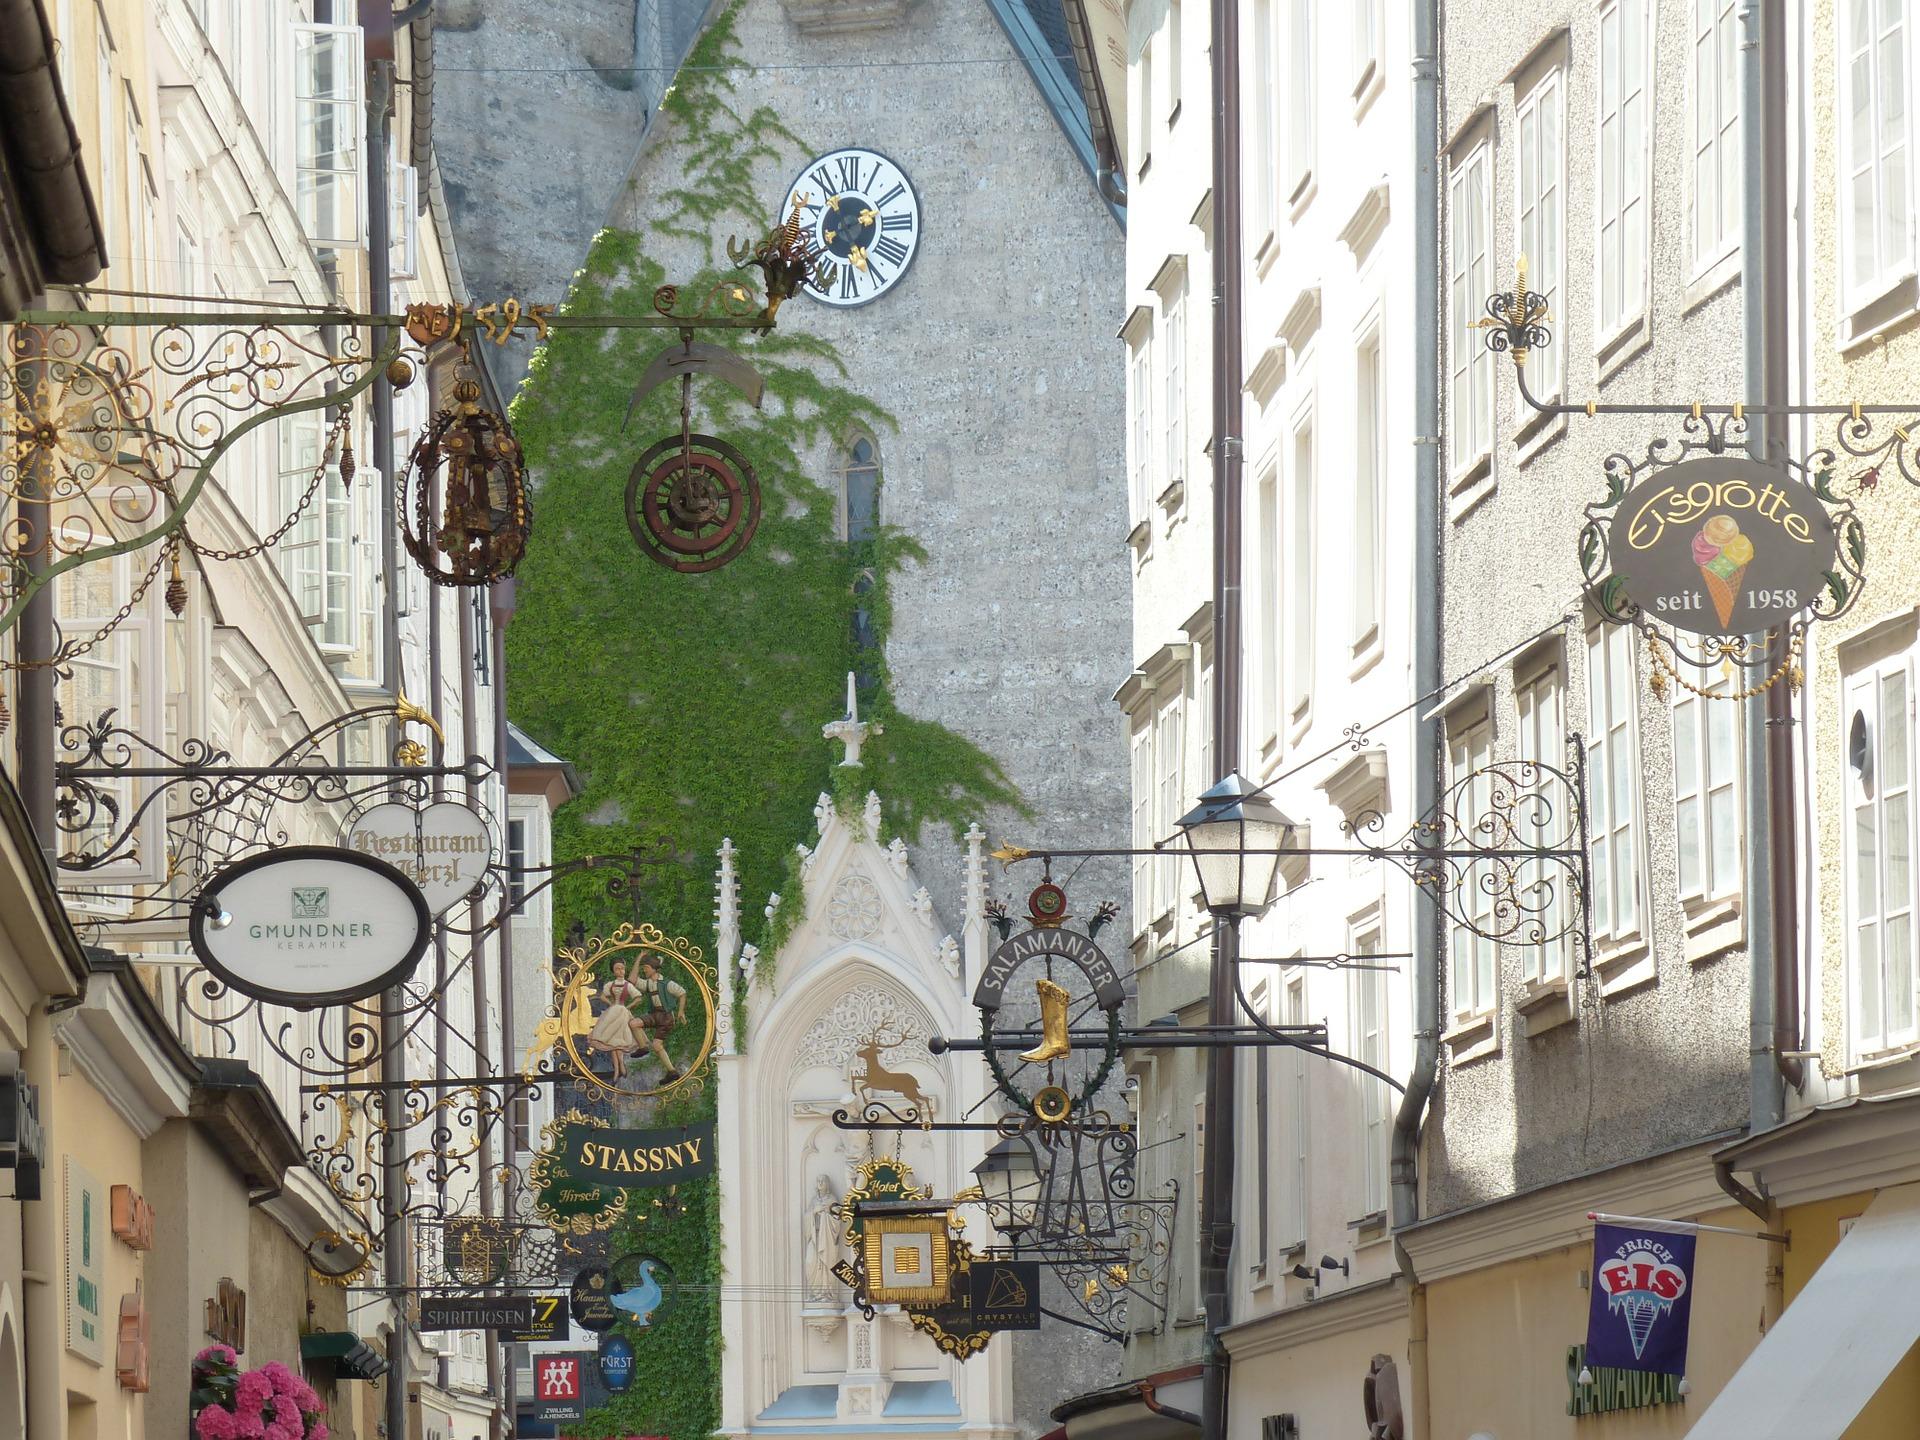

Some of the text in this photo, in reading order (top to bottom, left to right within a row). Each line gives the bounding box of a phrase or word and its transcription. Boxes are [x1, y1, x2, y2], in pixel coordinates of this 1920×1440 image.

[1628, 480, 1815, 550] Eisgrotte
[1656, 589, 1798, 612] seit 1958
[249, 923, 373, 939] GMUNDNER
[277, 940, 347, 950] KERAMIK
[984, 932, 1113, 990] SALAMANDER
[580, 1137, 702, 1173] STASSNY
[868, 1179, 900, 1193] Hotel
[1616, 1238, 1674, 1263] FRISCH
[1602, 1263, 1684, 1299] EIS
[427, 1309, 525, 1325] SPIRITUOSEN
